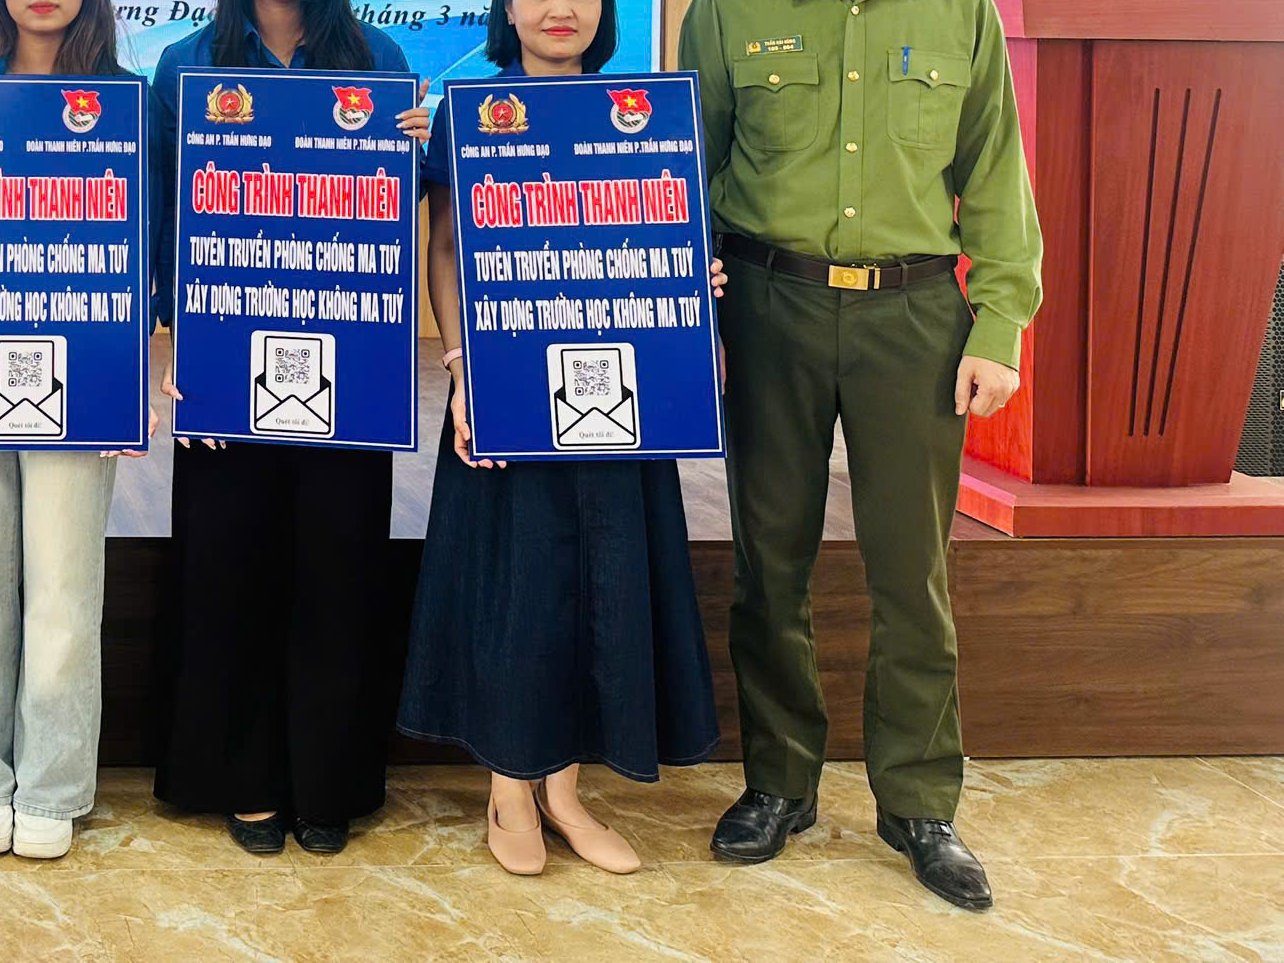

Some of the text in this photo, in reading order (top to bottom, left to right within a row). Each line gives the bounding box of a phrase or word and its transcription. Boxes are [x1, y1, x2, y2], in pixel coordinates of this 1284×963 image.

[436, 4, 451, 26] 3
[28, 176, 83, 221] THANH
[86, 168, 127, 221] NIÊN
[192, 161, 400, 221] CÔNG TRÌNH THANH NIÊN
[472, 169, 689, 229] CÔNG TRÌNH THANH NIÊN
[7, 237, 44, 273] PHÒNG
[47, 233, 85, 273] CHỐNG
[88, 244, 106, 274] MA
[108, 238, 129, 274] TUÝ
[189, 229, 401, 275] TUYÊN TRUYỀN PHÒNG CHỐNG MA TUÝ
[474, 238, 694, 282] TUYÊN TRUYỀN PHÒNG CHỐNG MA TUÝ
[24, 292, 47, 328] HỌC
[50, 286, 88, 322] KHÔNG
[91, 292, 109, 322] MA
[111, 286, 132, 322] TUÝ
[185, 278, 404, 325] XÂY DỰNG TRƯỜNG HỌC KHÔNG MA TUÝ
[474, 290, 701, 337] XÂY DỰNG TRƯỜNG HỌC KHÔNG MA TUÝ
